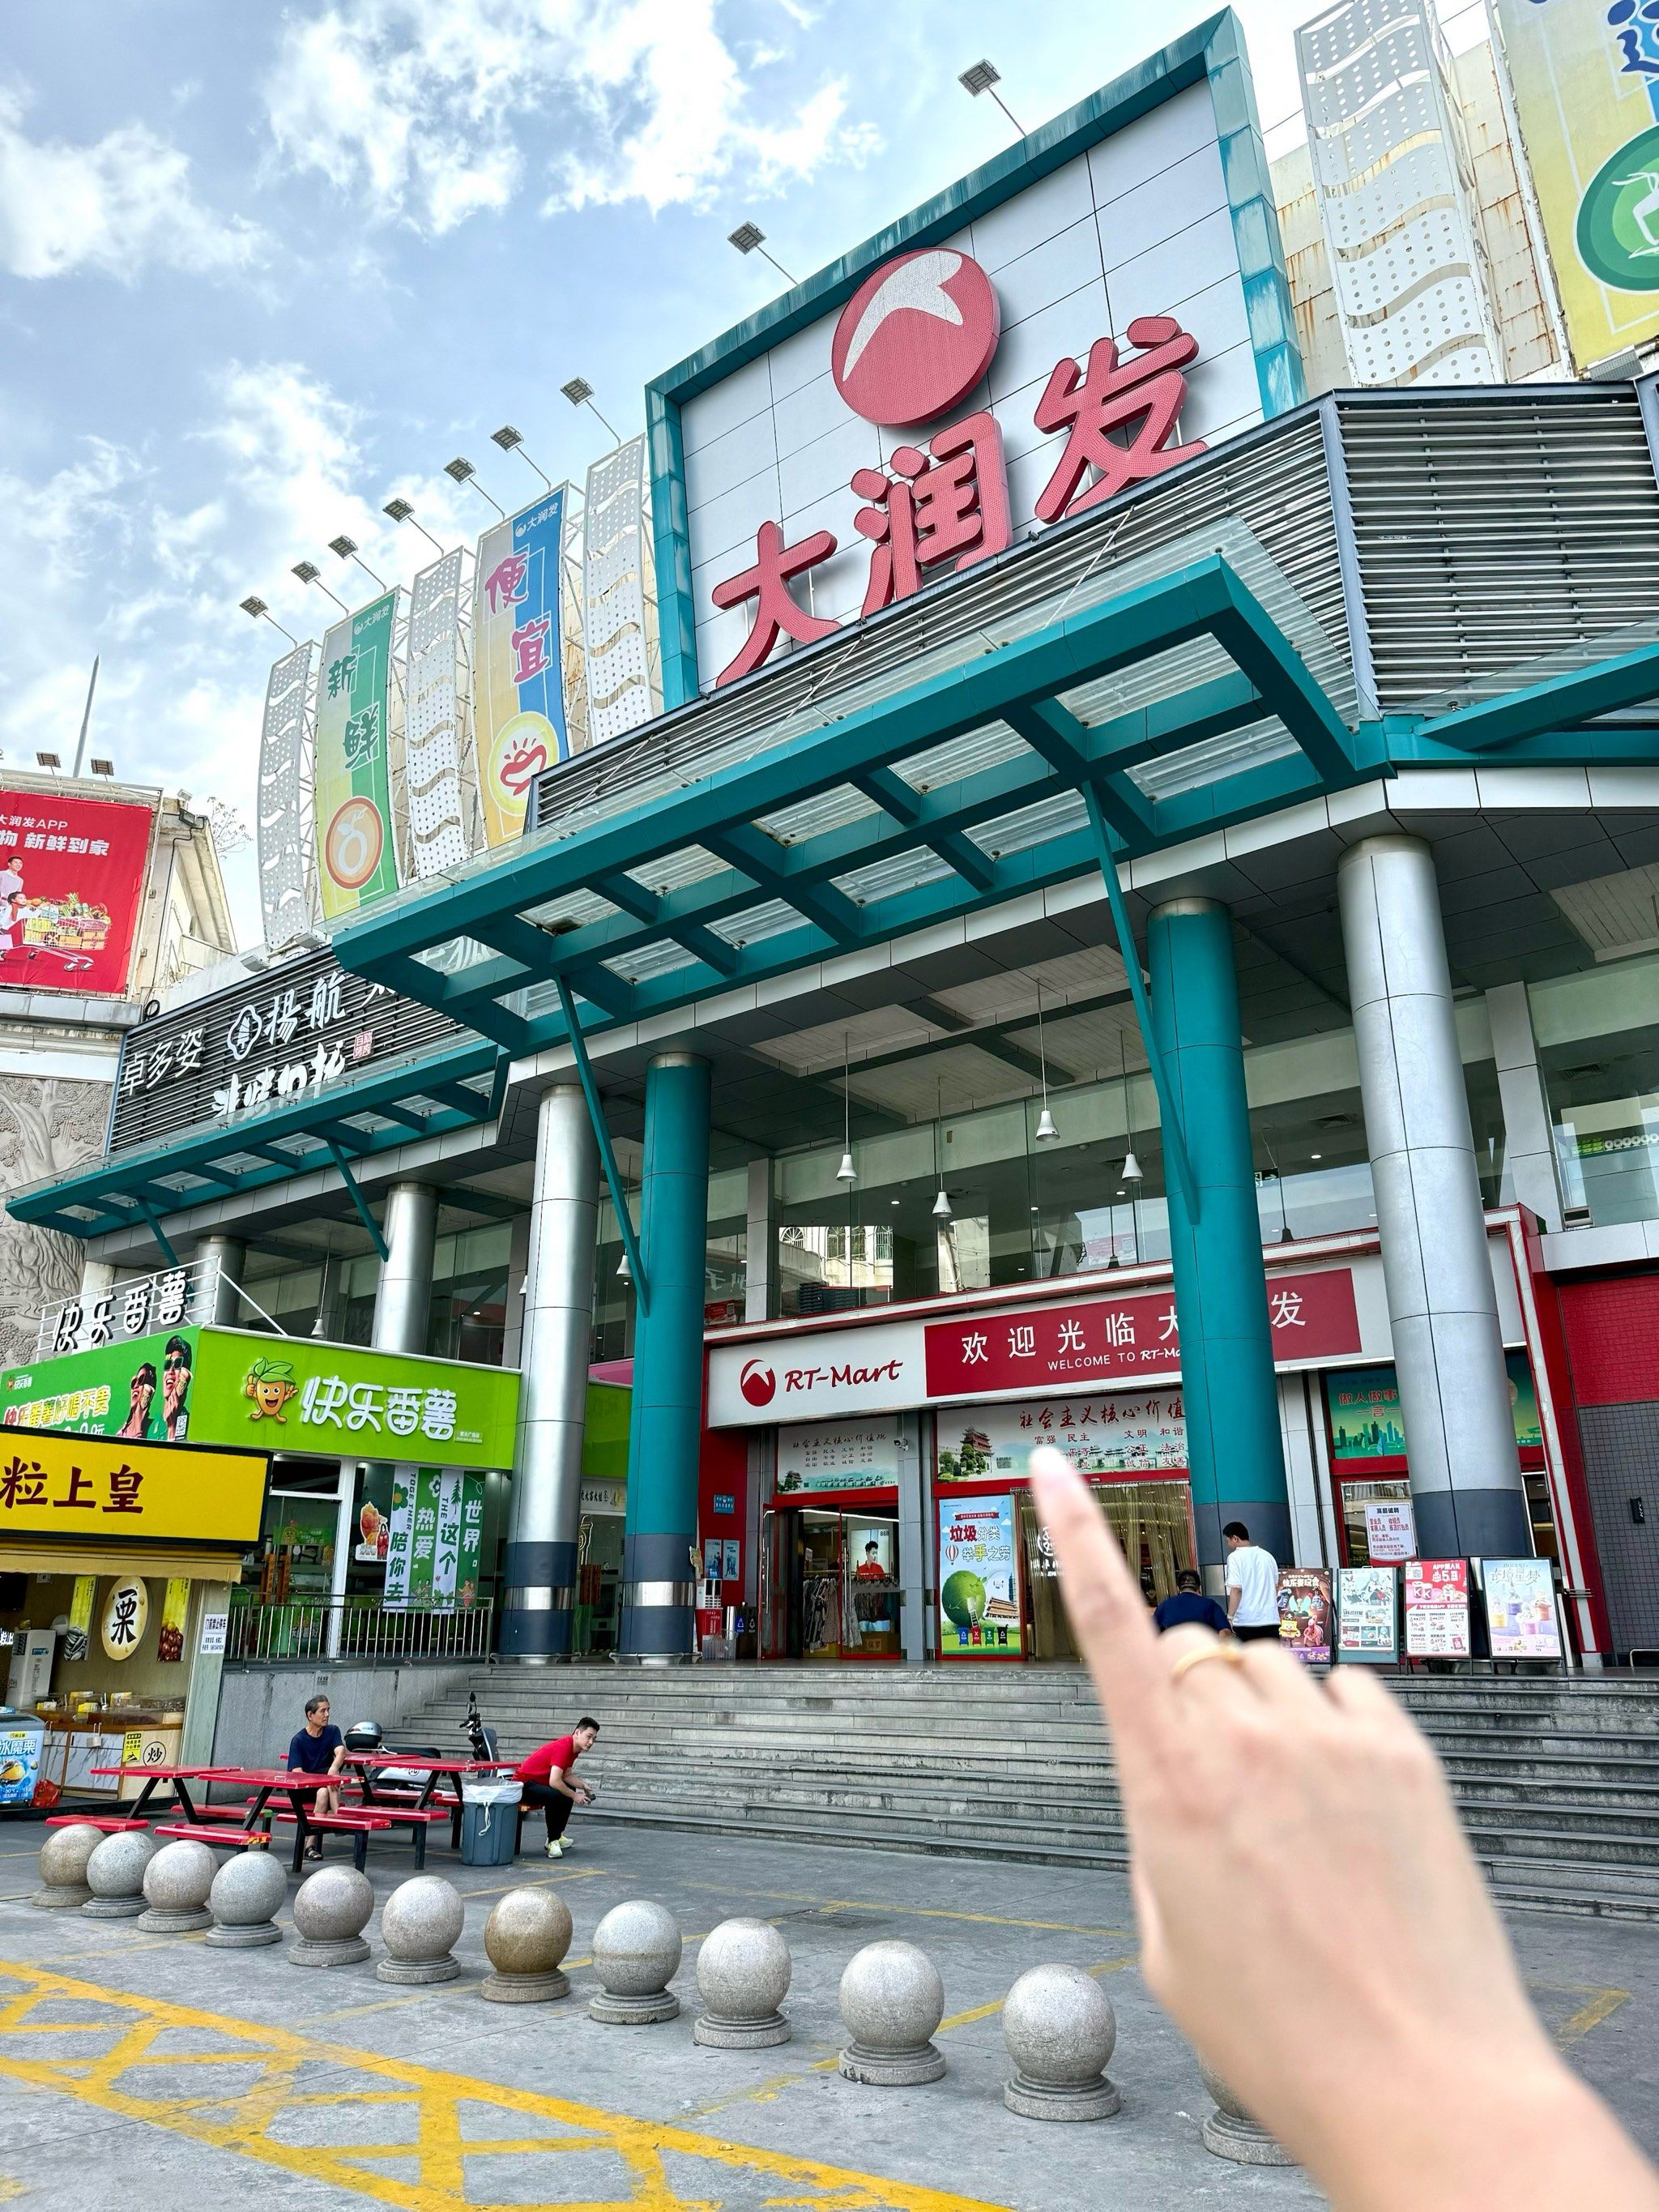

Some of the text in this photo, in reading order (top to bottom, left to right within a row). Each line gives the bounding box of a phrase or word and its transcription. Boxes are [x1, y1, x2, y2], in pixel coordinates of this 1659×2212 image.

[527, 502, 559, 532] 大润发
[710, 316, 1210, 689] 大润发
[363, 604, 390, 631] 大润发
[484, 553, 566, 685] 便宜
[328, 654, 379, 770] 新鲜
[24, 831, 109, 856] 新鲜到家
[121, 1027, 204, 1095] 卓多姿
[52, 1270, 186, 1352] 快乐番薯
[960, 1291, 1307, 1366] 欢迎光临大发
[784, 1359, 905, 1394] RT-Mart
[1047, 1354, 1111, 1371] WELCOME
[1118, 1352, 1137, 1365] TO
[301, 1375, 457, 1441] 快乐番薯
[1034, 1427, 1183, 1445] 富强 民主 文明 和谐
[0, 1456, 144, 1514] 粒上皇
[441, 1497, 449, 1519] THE
[438, 1522, 460, 1575] 这个
[949, 1525, 1000, 1542] 垃圾分类
[962, 1544, 1010, 1562] 举手之劳
[385, 1531, 409, 1603] 陪你去
[111, 1588, 138, 1645] 栗
[147, 1747, 163, 1762] 炒
